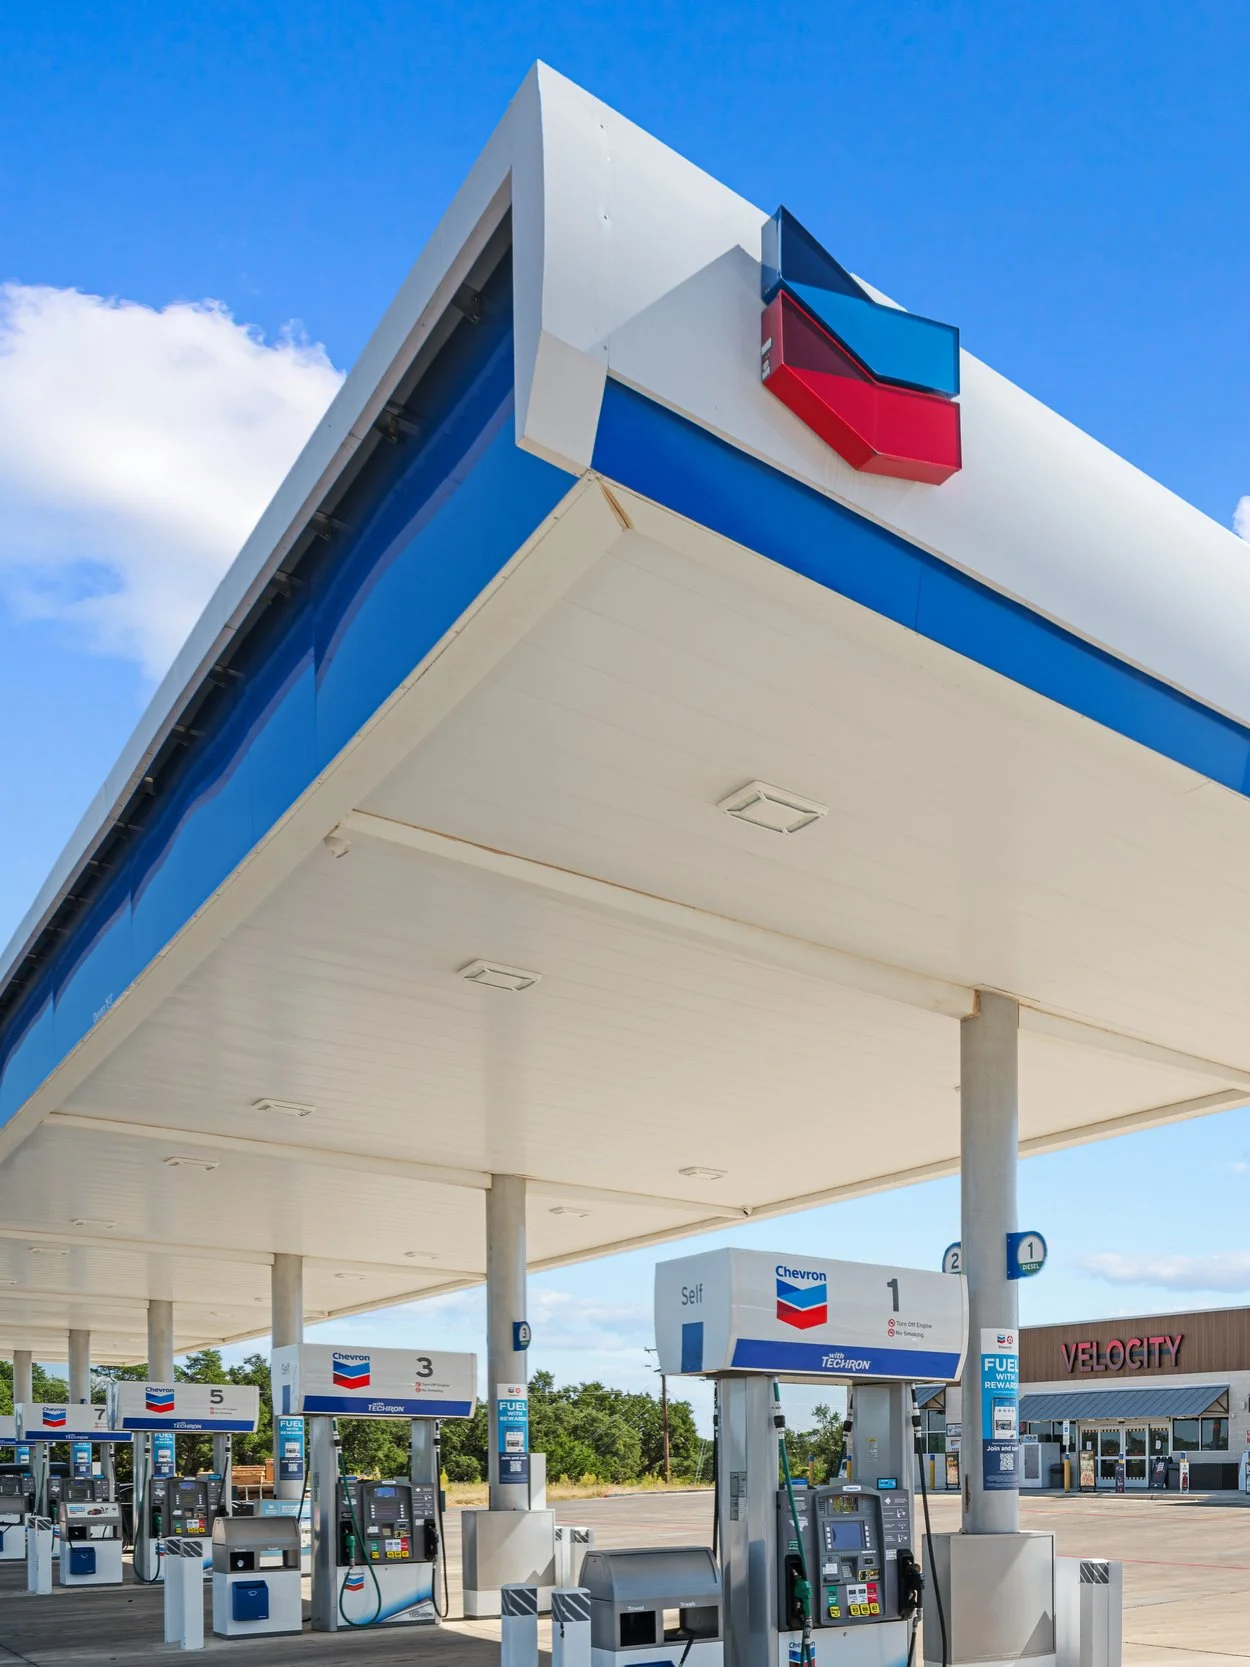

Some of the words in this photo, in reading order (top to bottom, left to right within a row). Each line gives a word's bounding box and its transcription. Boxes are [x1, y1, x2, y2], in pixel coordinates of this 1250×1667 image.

[1027, 1242, 1034, 1259] 1
[951, 1252, 960, 1270] 2
[1022, 1263, 1040, 1271] DIESEL
[775, 1265, 827, 1282] Chevron
[681, 1283, 704, 1306] Self
[886, 1278, 900, 1312] 1
[522, 1328, 528, 1338] 3
[916, 1322, 933, 1330] Engine
[332, 1352, 370, 1361] Chevron
[1061, 1334, 1184, 1373] VELOCITY
[415, 1357, 434, 1378] 3
[821, 1356, 871, 1372] TECHRON
[984, 1358, 1019, 1372] FUEL
[210, 1389, 224, 1405] 5
[94, 1408, 106, 1420] 7
[368, 1404, 405, 1412] TECHRON
[500, 1402, 527, 1411] FUEL
